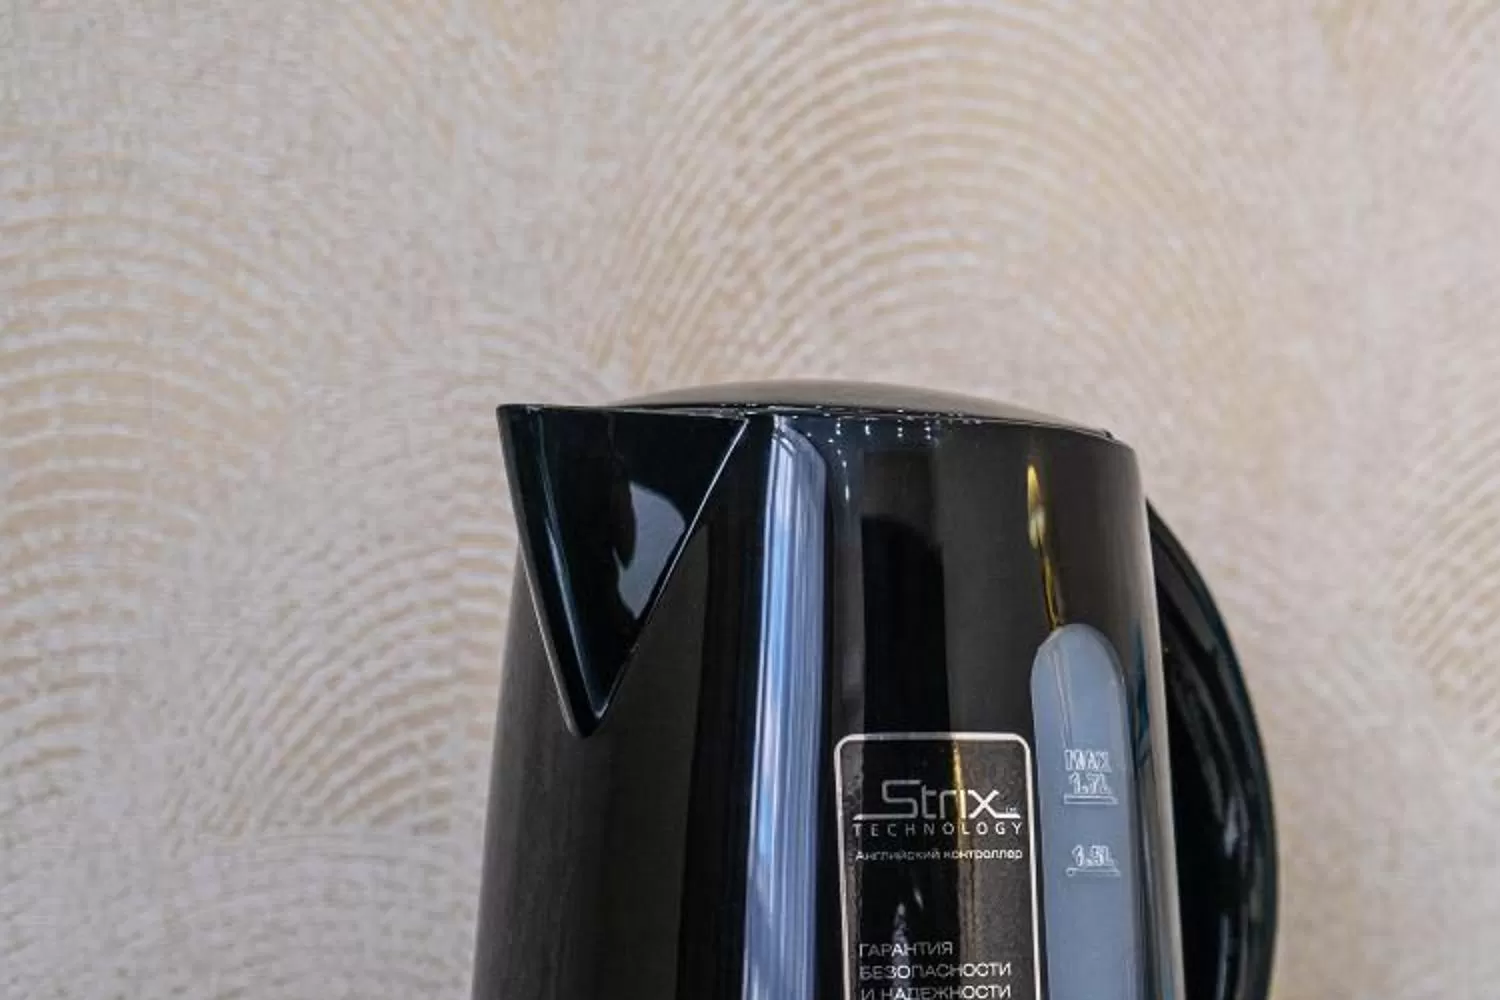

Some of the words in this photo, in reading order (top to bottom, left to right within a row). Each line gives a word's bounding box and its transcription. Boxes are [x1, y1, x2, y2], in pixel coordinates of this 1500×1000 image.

[853, 779, 1021, 820] Strix
[852, 821, 1023, 837] TECHNOLOGY
[855, 850, 941, 861] Английский
[943, 849, 1023, 861] контроллер
[858, 942, 953, 958] ГАРАНТИЯ
[859, 962, 1012, 980] БЕЗОПАСНОСТИ
